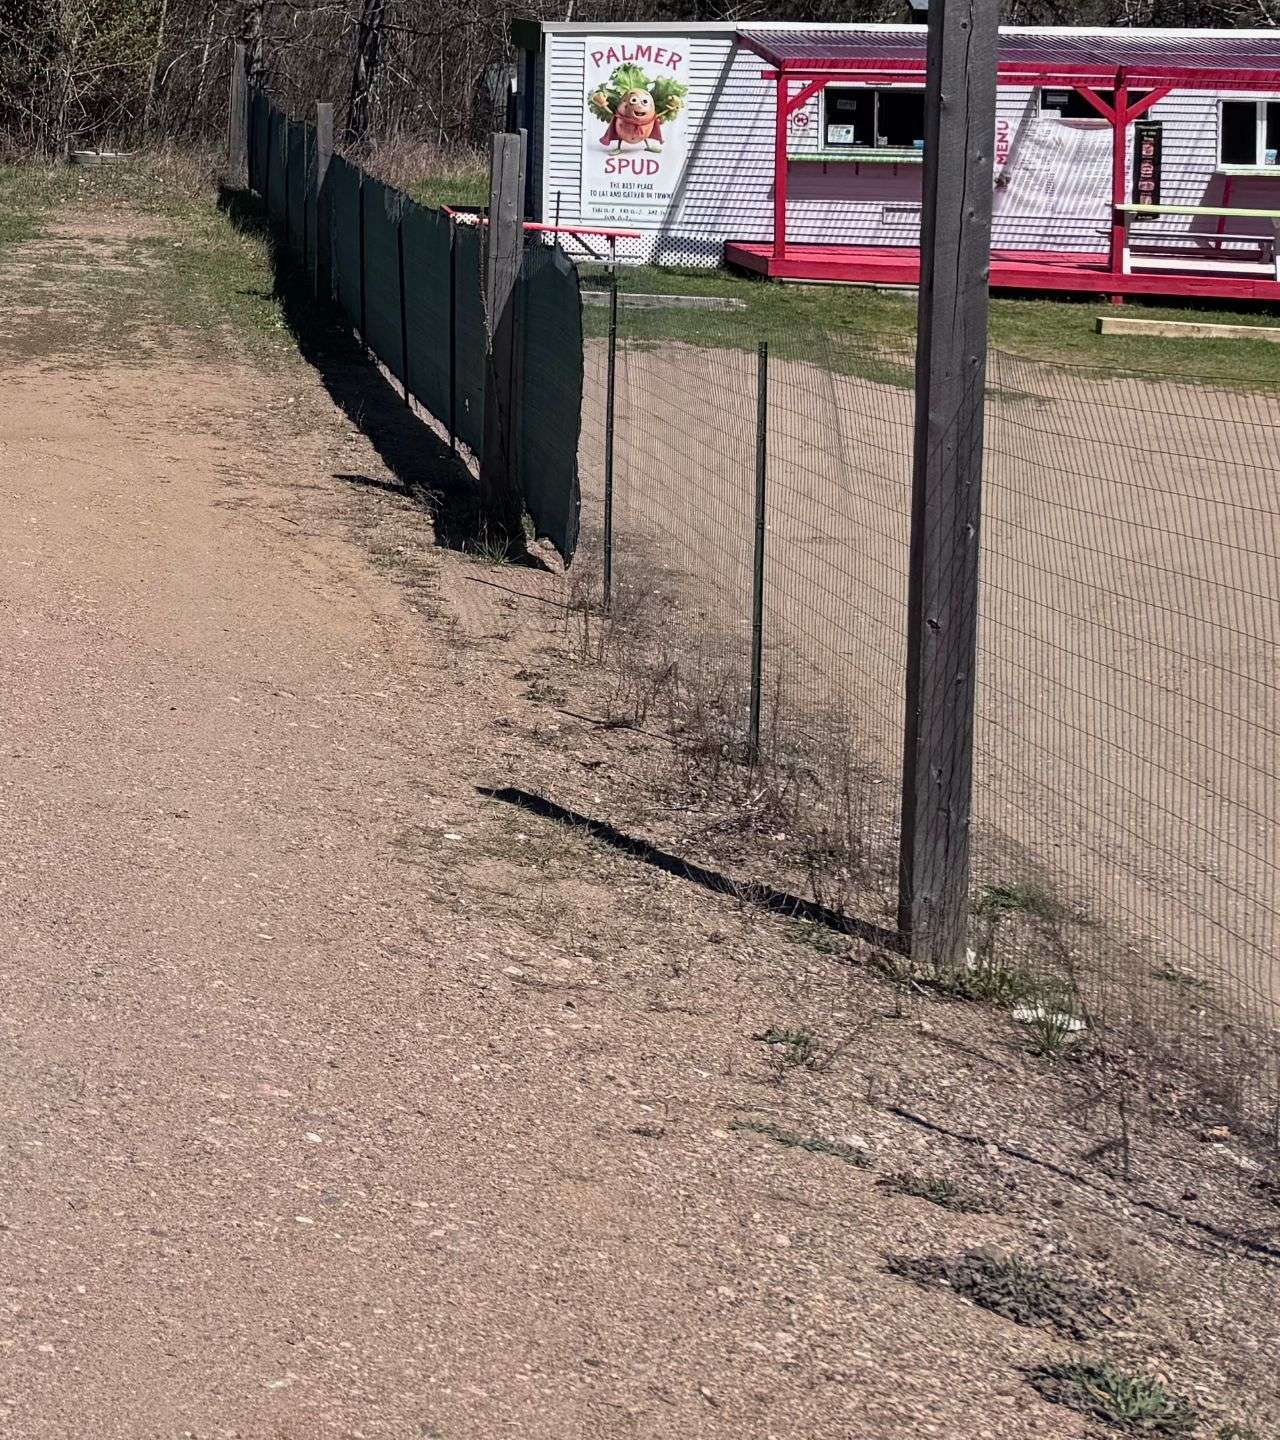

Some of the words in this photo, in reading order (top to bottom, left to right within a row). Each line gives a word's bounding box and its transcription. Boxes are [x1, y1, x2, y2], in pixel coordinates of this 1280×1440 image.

[591, 44, 682, 71] PALMER
[996, 120, 1009, 166] MENU
[604, 158, 659, 175] SPUD
[590, 189, 597, 197] TO
[609, 190, 621, 198] AND
[622, 182, 635, 190] BEST
